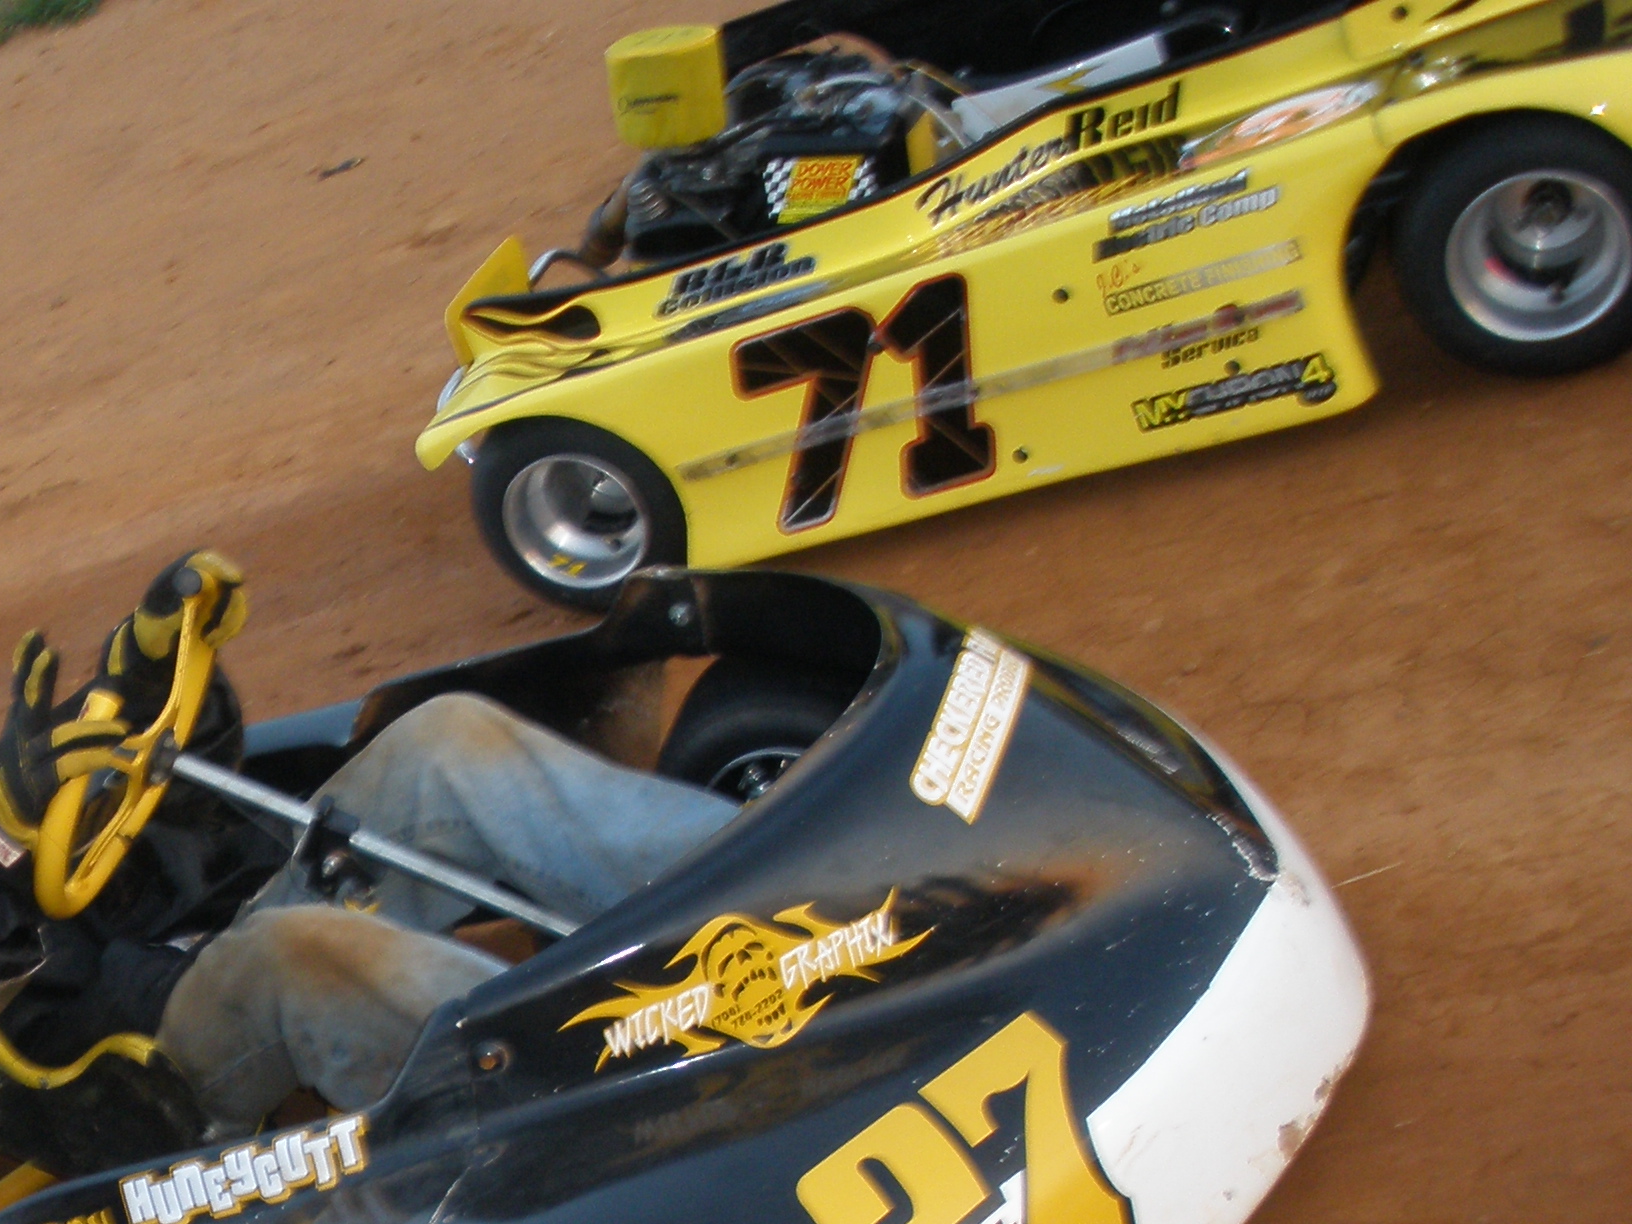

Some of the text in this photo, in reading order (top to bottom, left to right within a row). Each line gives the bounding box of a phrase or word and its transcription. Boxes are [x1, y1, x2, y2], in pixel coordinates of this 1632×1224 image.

[1104, 264, 1204, 316] CONCRETE
[730, 272, 996, 535] 71
[912, 651, 994, 803] CHECKERED
[956, 713, 1001, 803] RACING
[604, 912, 895, 1058] WICKED GRAPHIX
